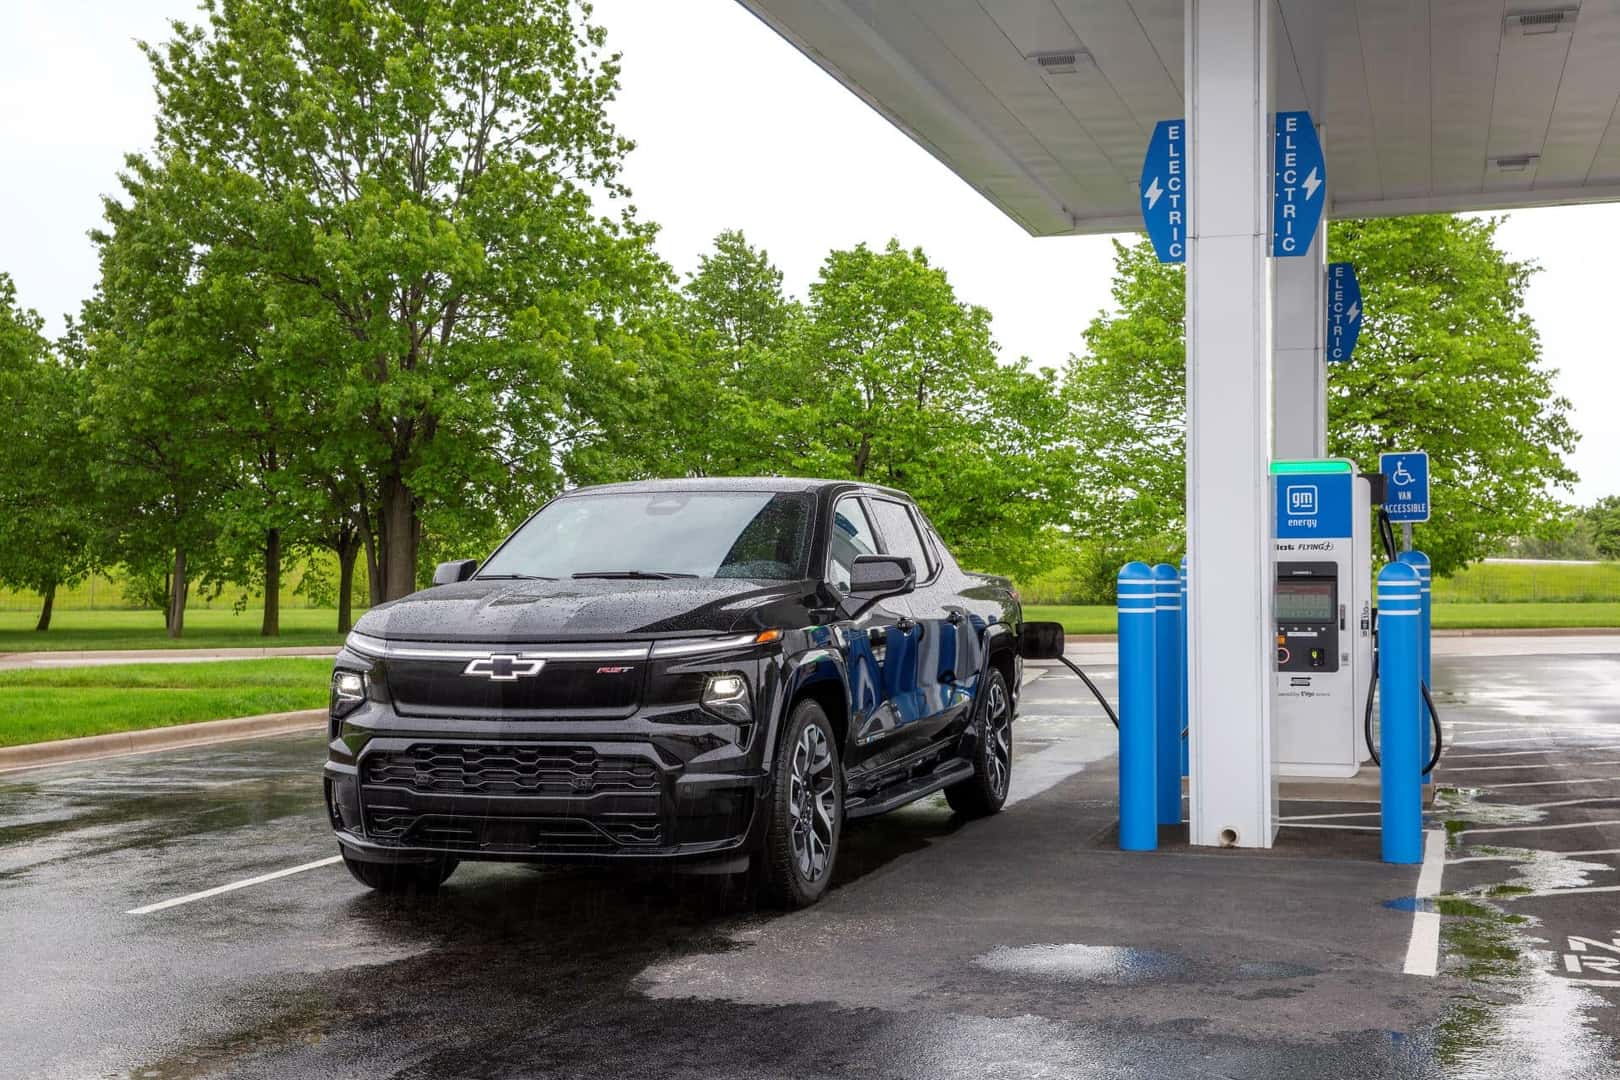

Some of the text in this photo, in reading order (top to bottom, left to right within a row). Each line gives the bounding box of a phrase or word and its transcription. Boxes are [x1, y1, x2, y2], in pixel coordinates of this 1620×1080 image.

[1282, 117, 1297, 252] ELECTRIC
[1168, 126, 1182, 258] ELECTRIC
[1333, 267, 1343, 359] ELECTRIC
[1292, 492, 1313, 508] gm
[1398, 491, 1412, 501] VAN
[1384, 503, 1426, 513] ACCESSIBLE
[1287, 519, 1318, 529] energy
[1276, 543, 1294, 551] lot
